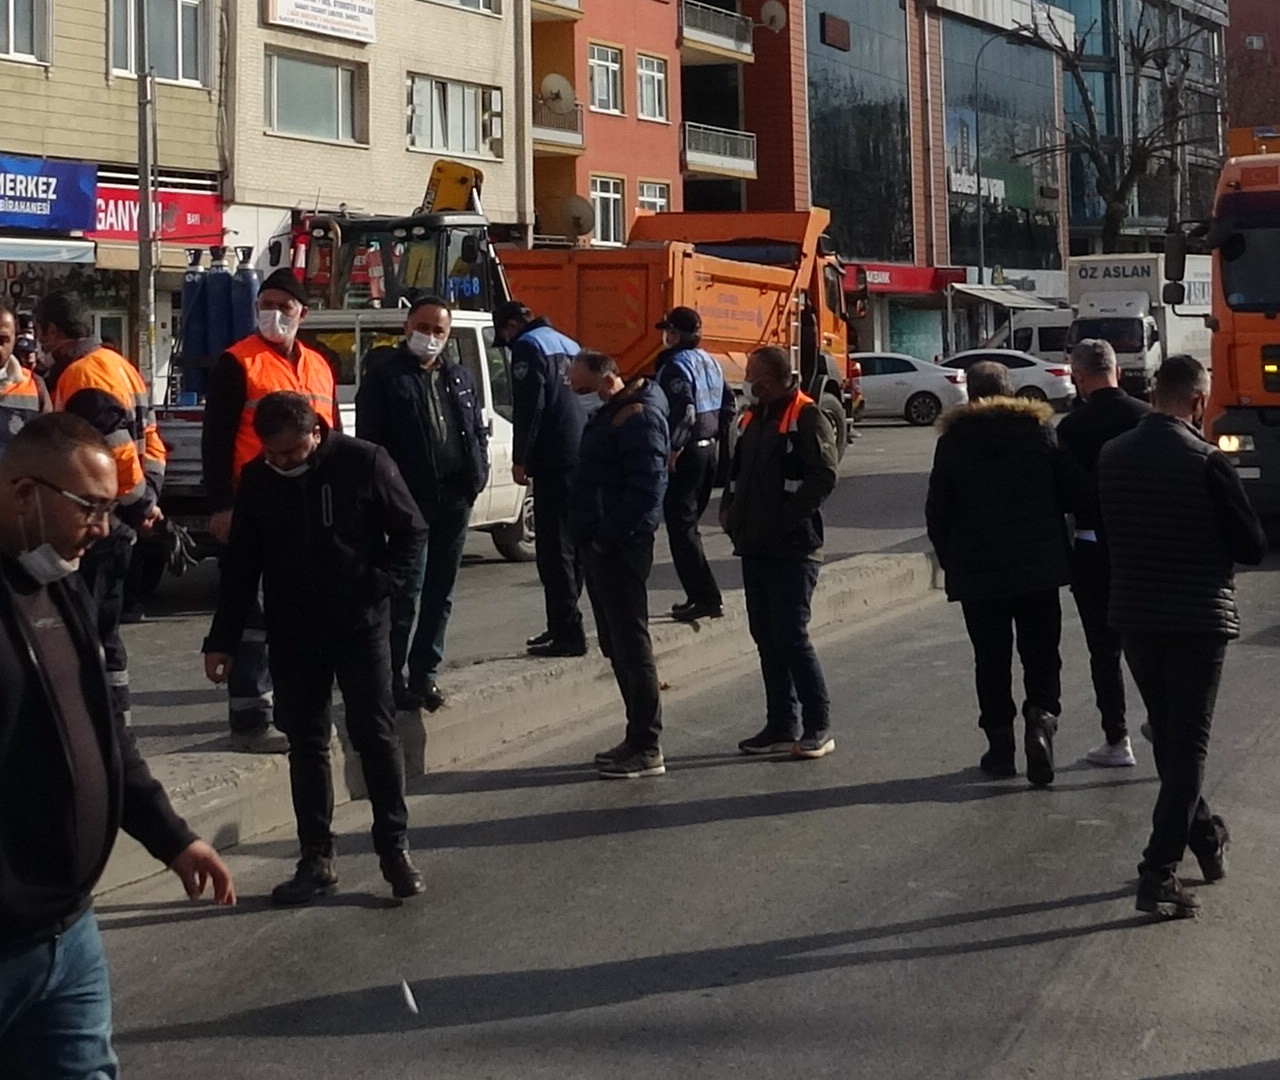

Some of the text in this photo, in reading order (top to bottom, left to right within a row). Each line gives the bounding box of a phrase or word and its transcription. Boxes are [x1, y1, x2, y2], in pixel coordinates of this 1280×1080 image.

[96, 197, 163, 232] GANYN
[1078, 264, 1151, 279] ÖZ ASLAN
